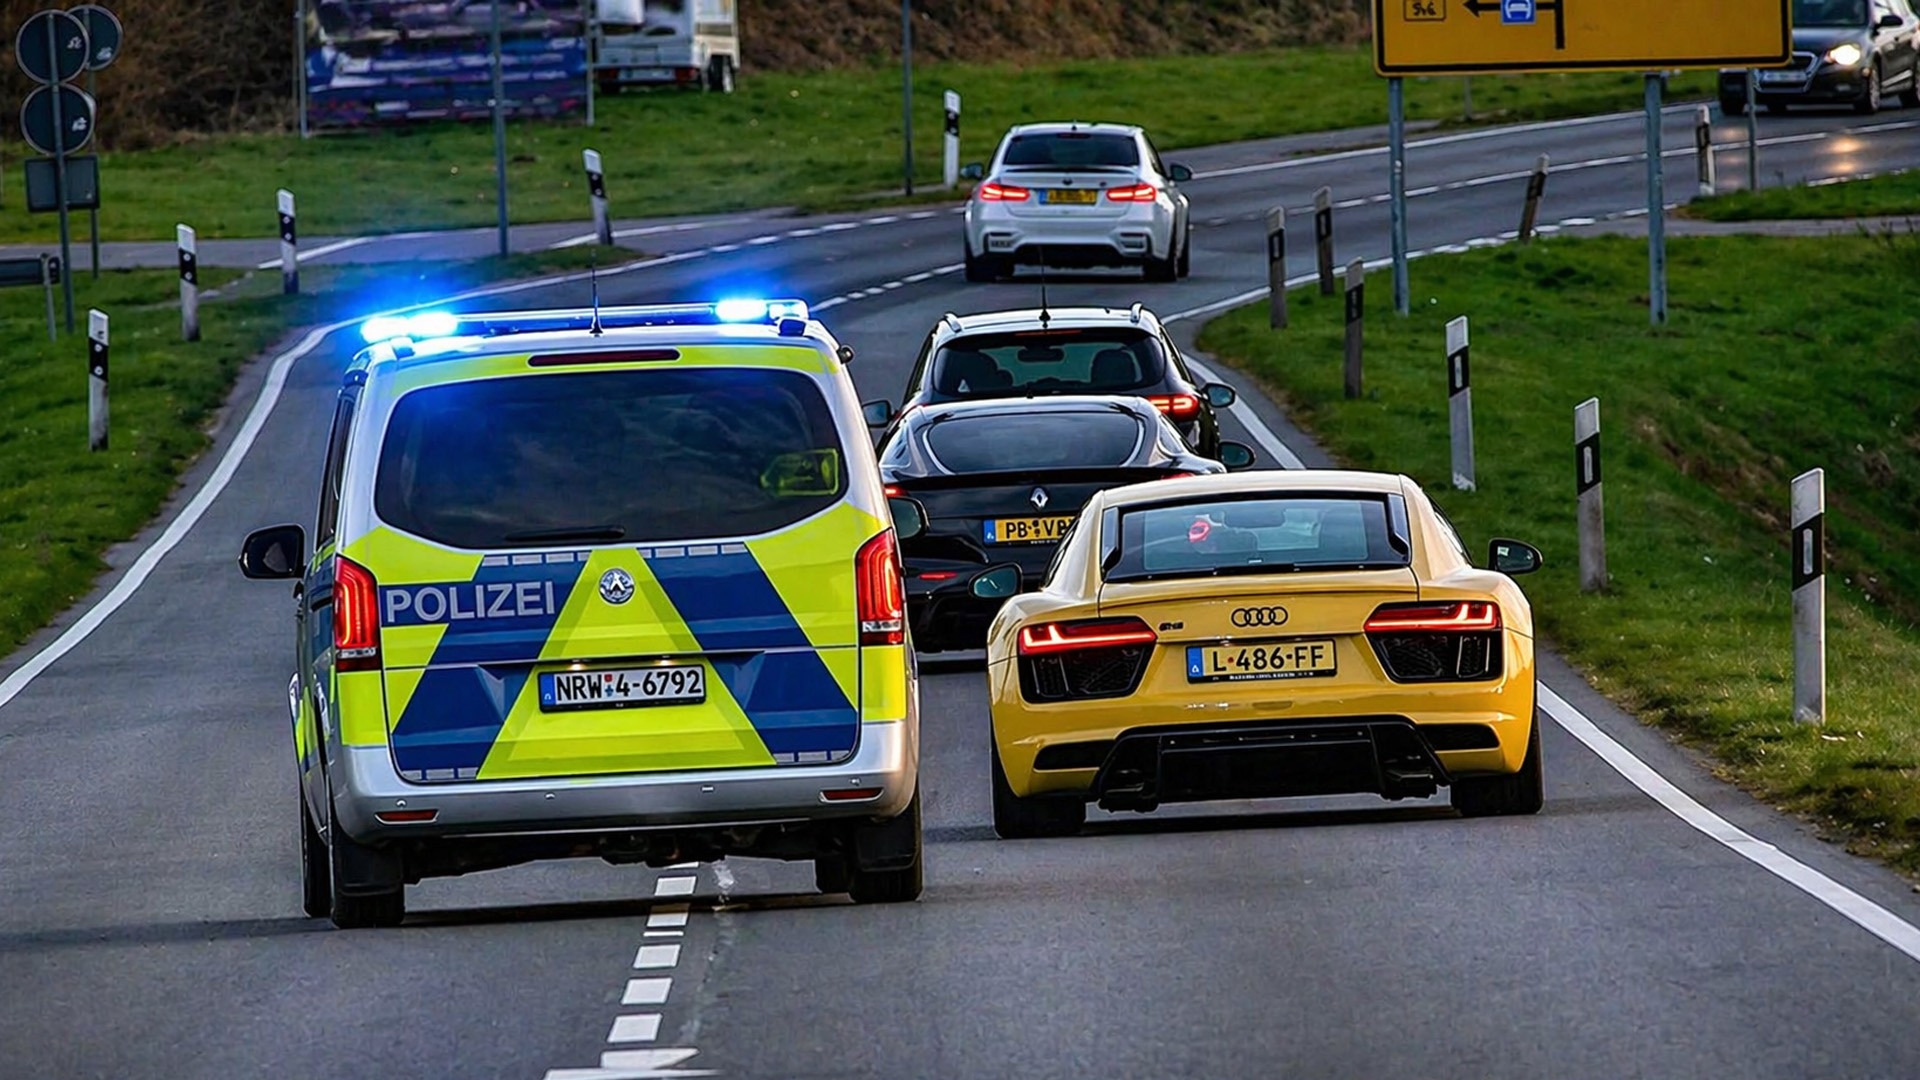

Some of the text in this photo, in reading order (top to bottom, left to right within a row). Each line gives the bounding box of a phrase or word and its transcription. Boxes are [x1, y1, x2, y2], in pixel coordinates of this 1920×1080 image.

[386, 581, 555, 622] POLIZEI
[556, 669, 702, 701] NRW 4-6792
